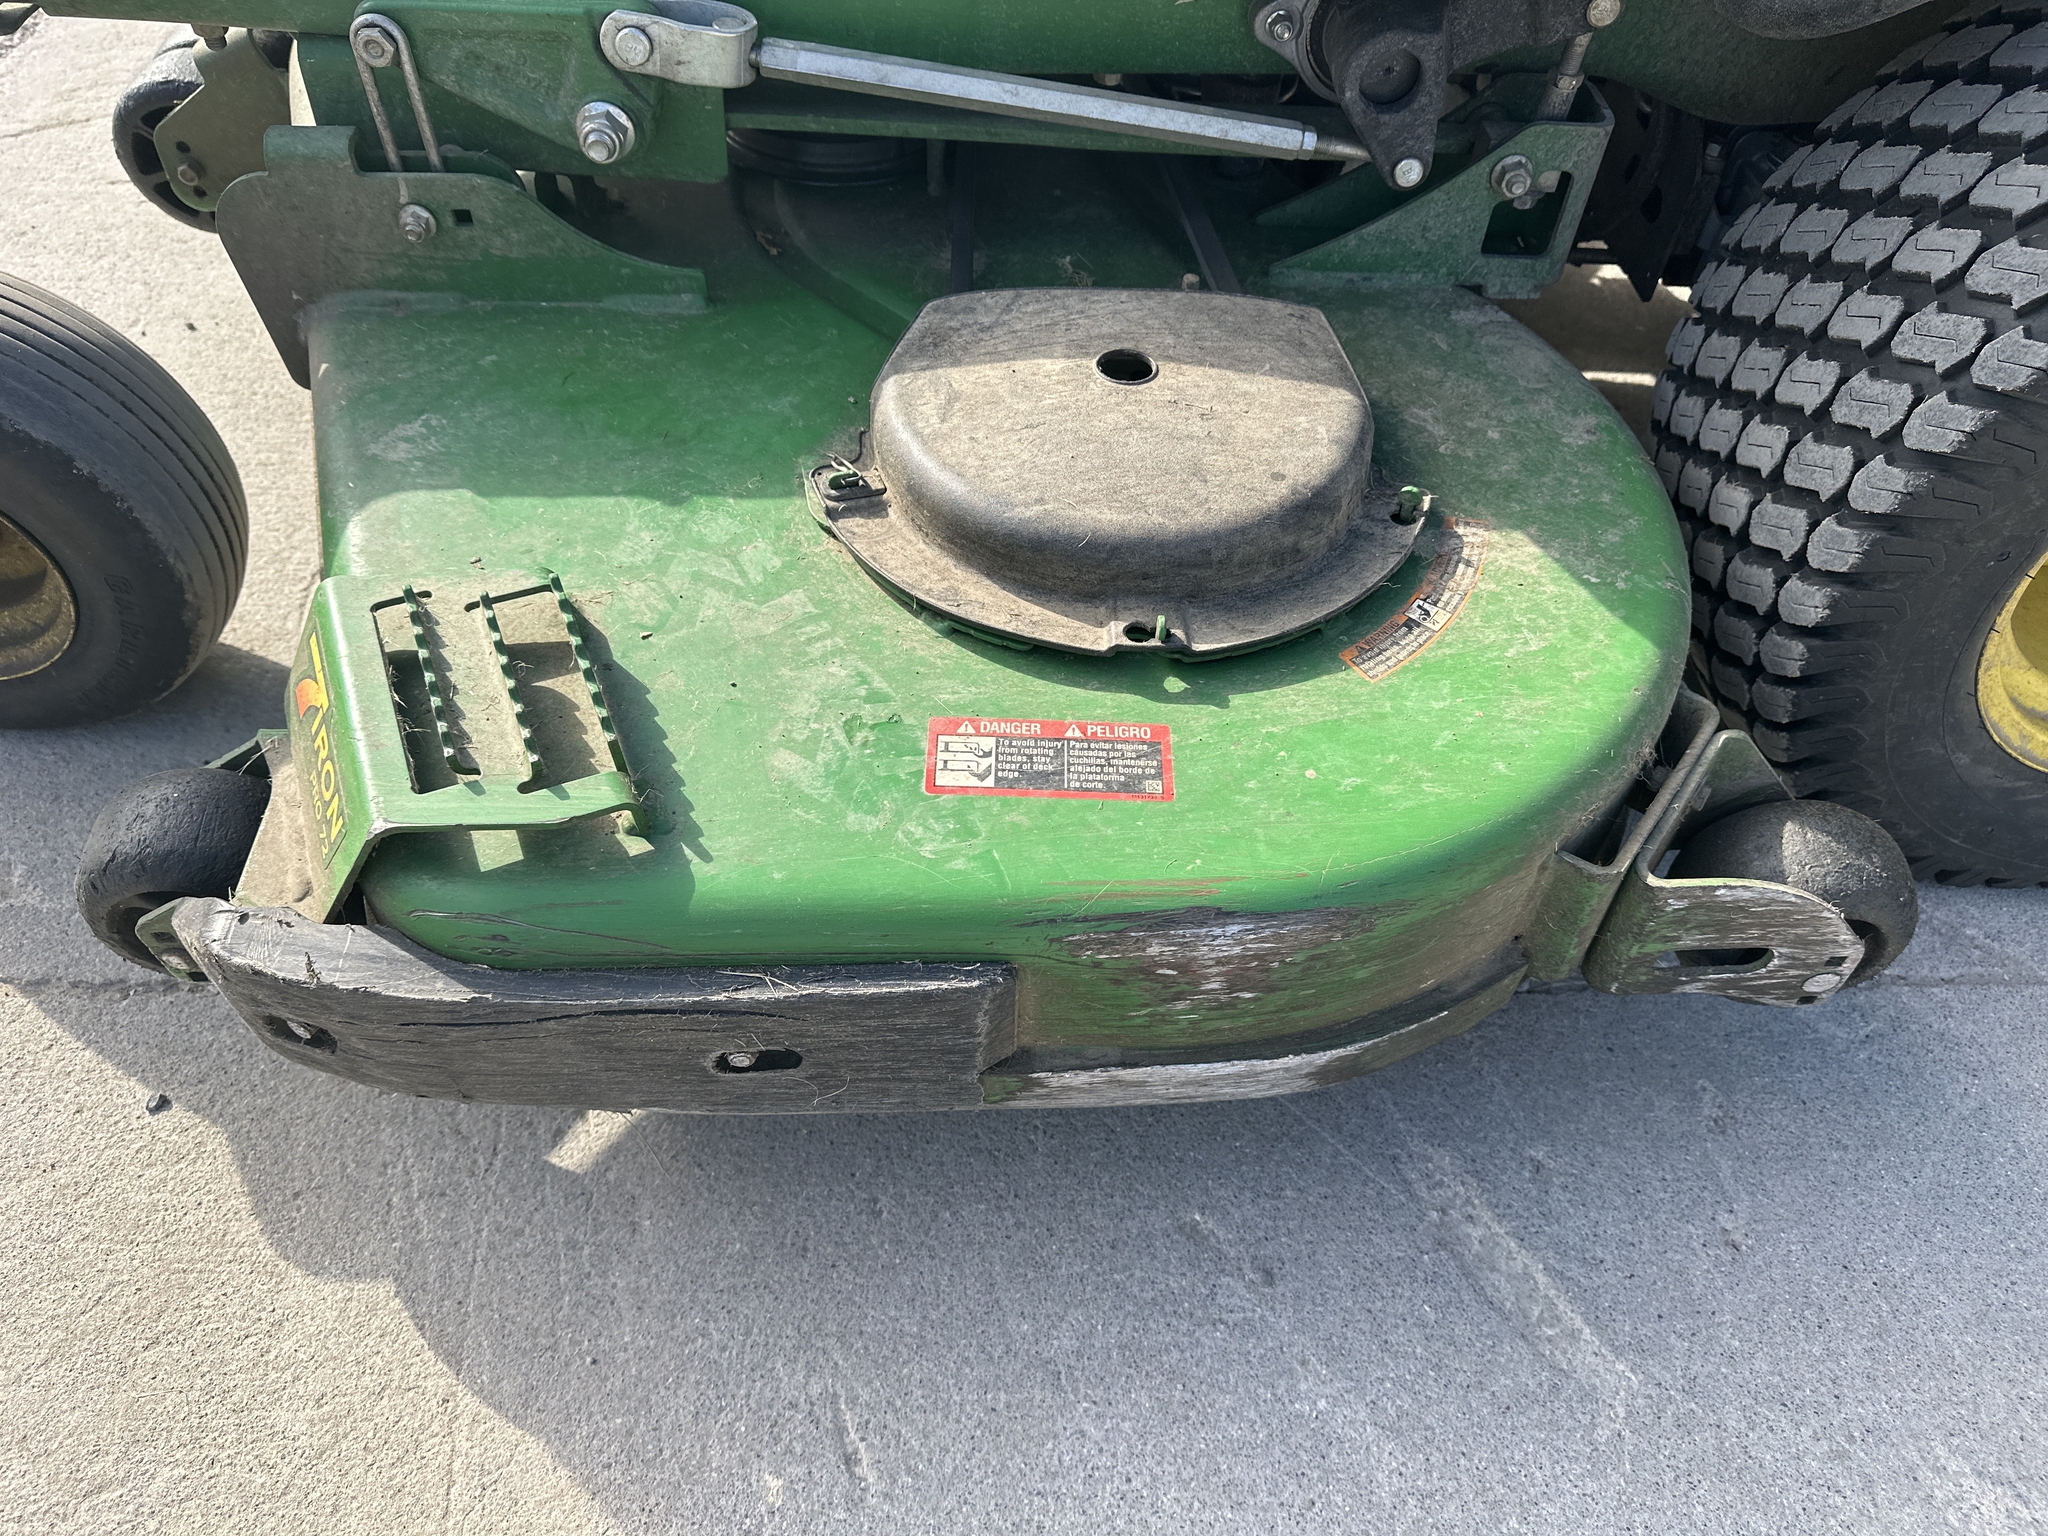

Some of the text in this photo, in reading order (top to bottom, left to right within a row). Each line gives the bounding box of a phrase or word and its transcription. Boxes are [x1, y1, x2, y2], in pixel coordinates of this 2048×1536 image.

[1362, 620, 1400, 647] WARNING
[1361, 647, 1380, 661] avoid
[1393, 626, 1409, 637] from
[980, 721, 1041, 735] DANGER
[1087, 725, 1151, 739] PELIGRO
[1037, 739, 1062, 749] injury
[1069, 740, 1148, 751] Para evitar lesiones
[997, 746, 1054, 756] from rotating
[1069, 749, 1137, 759] causadas por las
[1033, 755, 1051, 763] stay
[1069, 757, 1158, 767] cuchillas, mantenerse
[1033, 763, 1053, 771] deck
[1069, 765, 1156, 775] alejado del borde de
[997, 770, 1022, 778] edge.
[1069, 772, 1125, 781] la plataforma
[1069, 780, 1106, 789] de corte.
[309, 769, 329, 860] PRO 72
